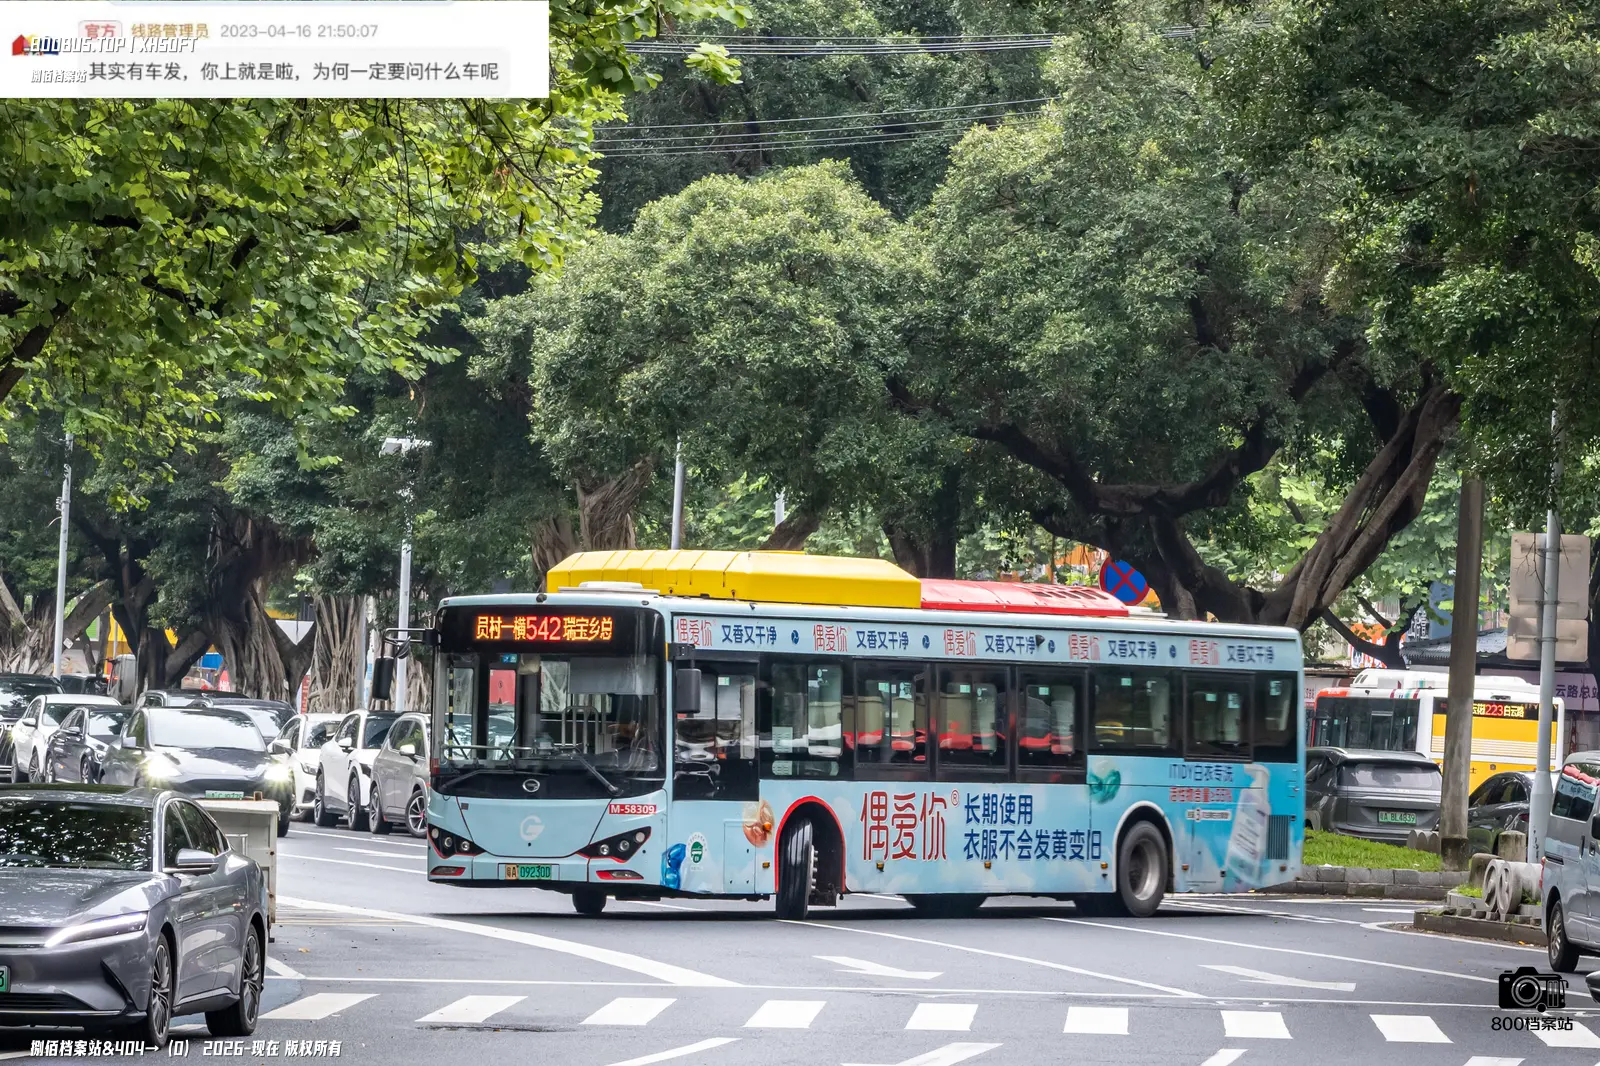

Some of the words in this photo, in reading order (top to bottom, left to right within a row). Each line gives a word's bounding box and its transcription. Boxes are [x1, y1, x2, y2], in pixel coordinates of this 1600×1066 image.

[722, 624, 777, 645] 又香又干净
[856, 630, 909, 650] 又香又干净
[985, 634, 1036, 654] 又香又干净
[610, 804, 655, 814] M-58309
[964, 793, 1034, 825] 长期使用
[963, 828, 1103, 861] 衣服不会发黄变旧
